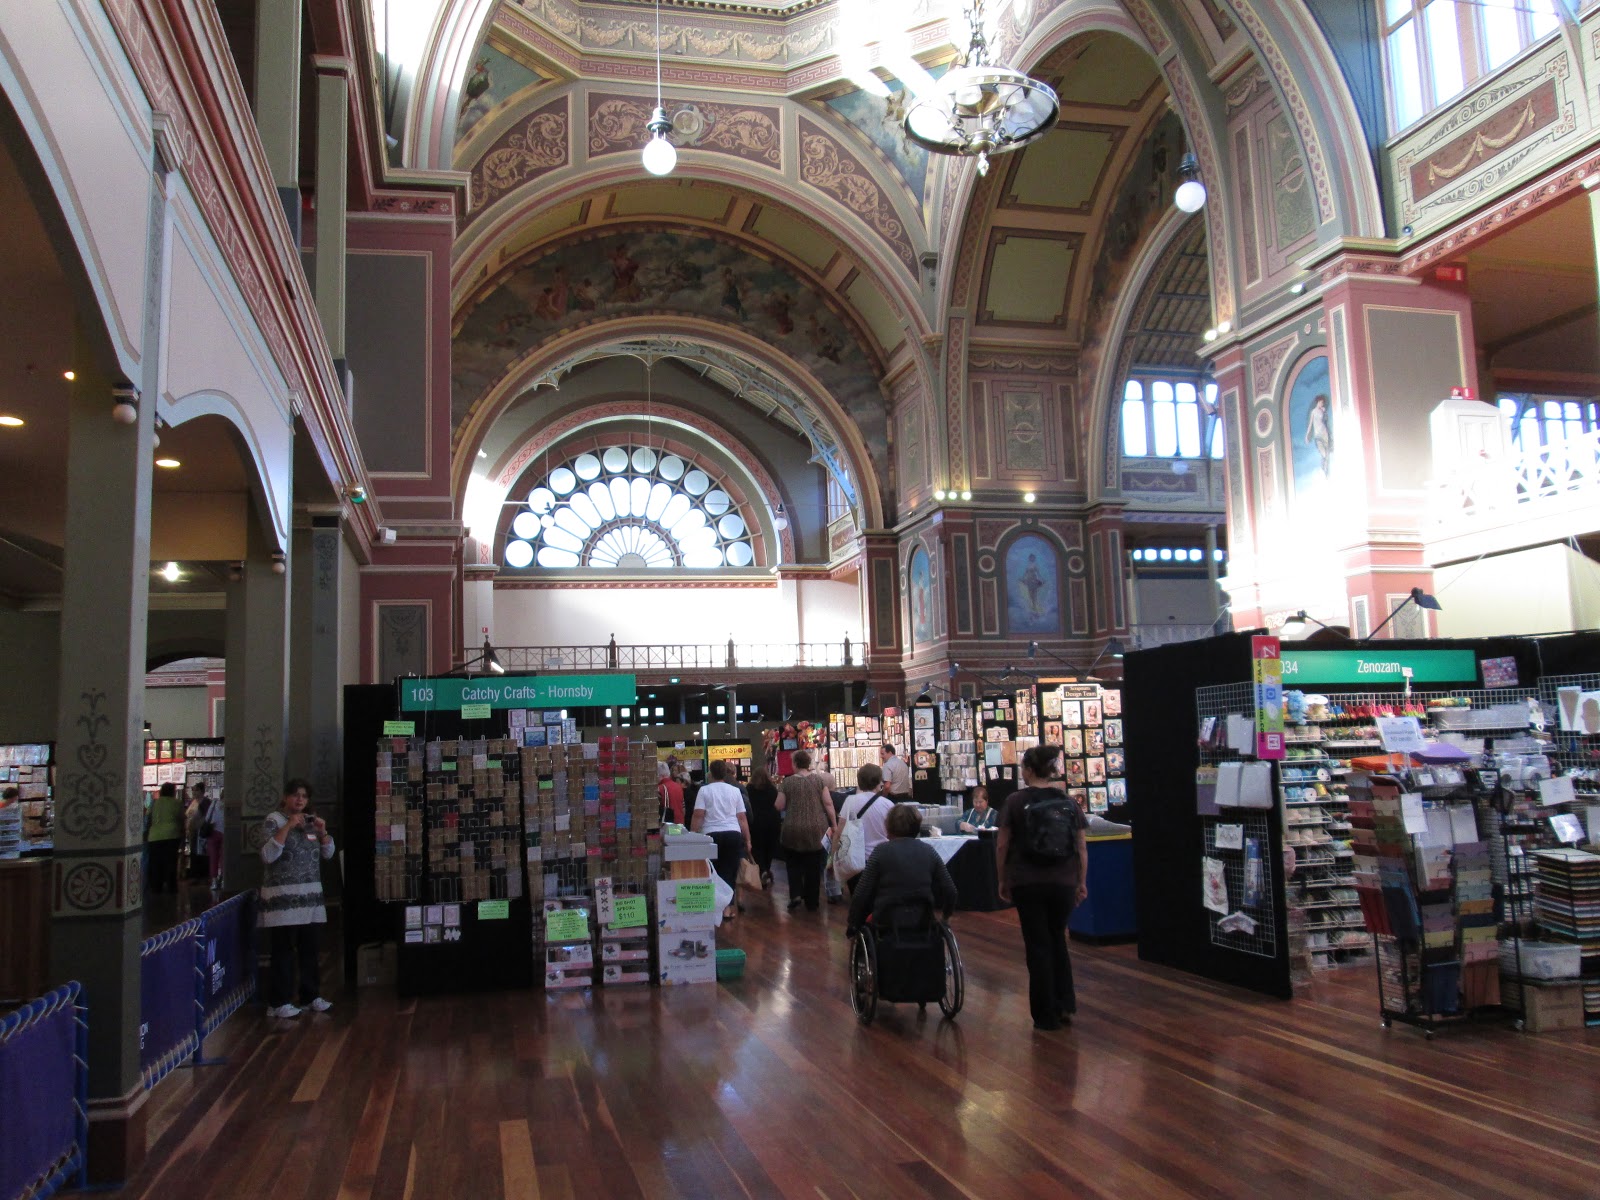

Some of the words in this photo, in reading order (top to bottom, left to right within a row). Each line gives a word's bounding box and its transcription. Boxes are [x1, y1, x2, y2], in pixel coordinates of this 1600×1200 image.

[1357, 659, 1401, 674] Zenozam
[411, 688, 434, 701] 103
[461, 686, 501, 702] Catchy
[504, 686, 536, 699] Crafts
[548, 685, 594, 700] Hornsby
[690, 748, 703, 756] Spo
[711, 747, 728, 755] Craft
[618, 911, 635, 920] $110
